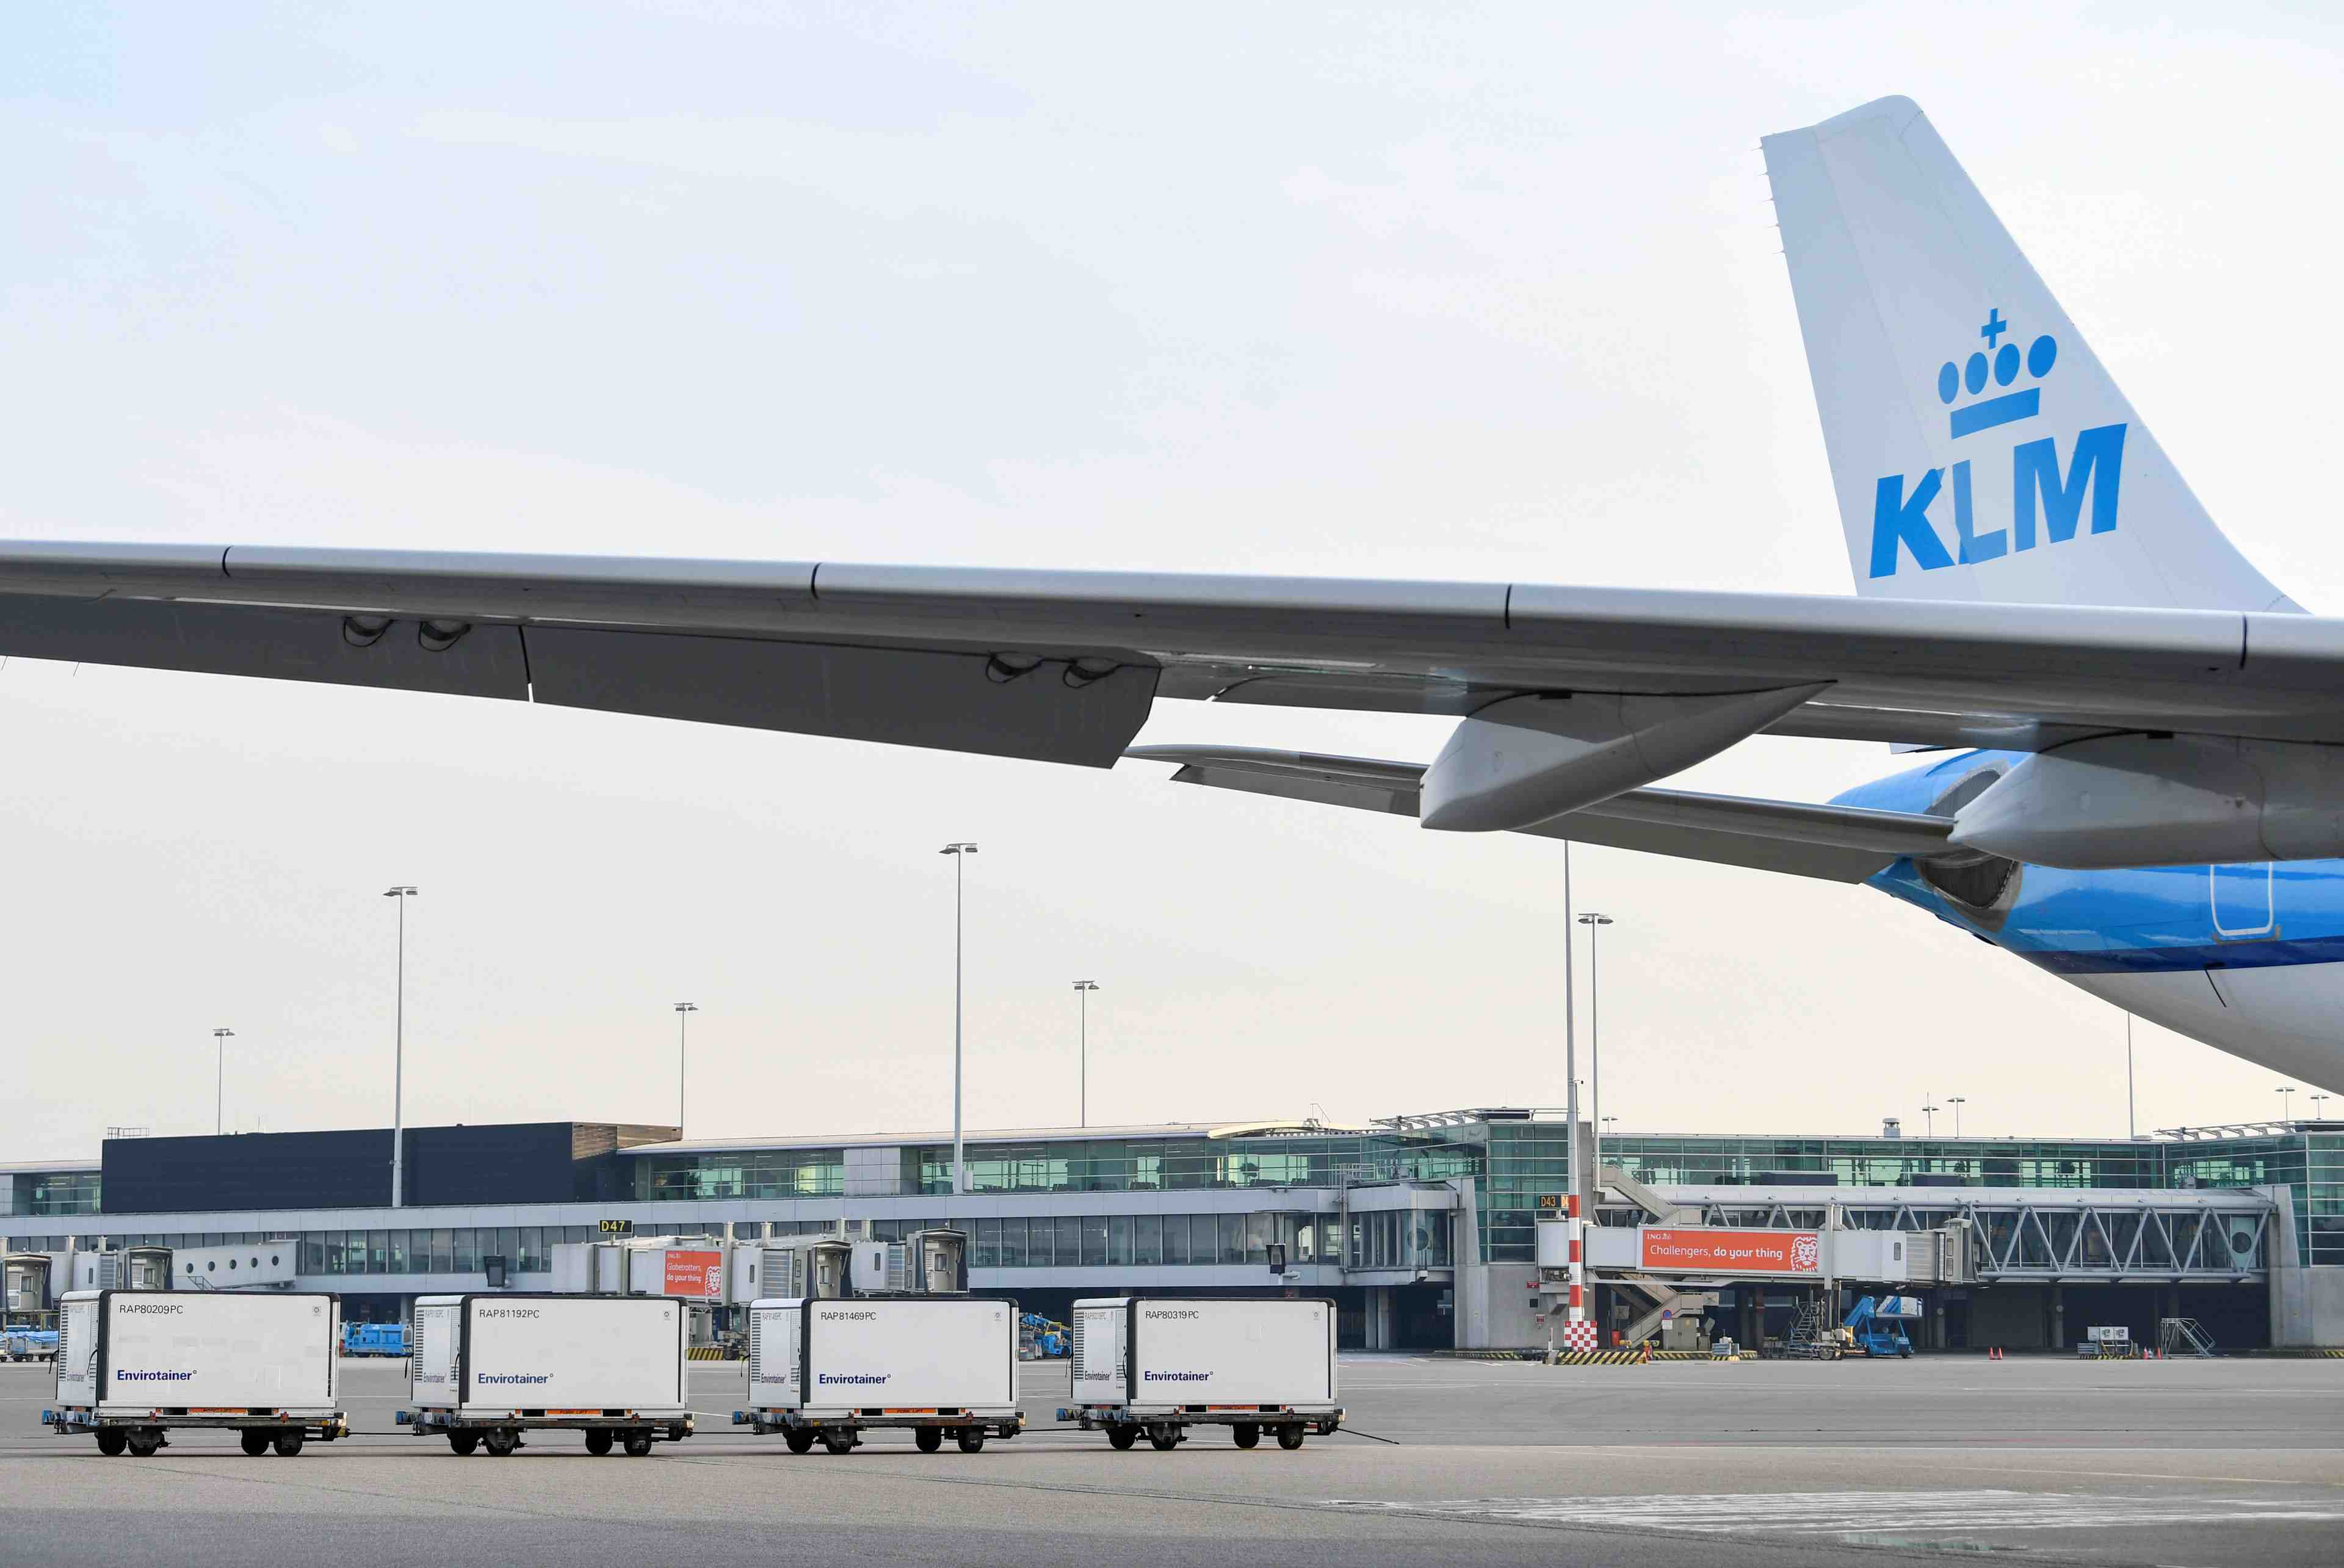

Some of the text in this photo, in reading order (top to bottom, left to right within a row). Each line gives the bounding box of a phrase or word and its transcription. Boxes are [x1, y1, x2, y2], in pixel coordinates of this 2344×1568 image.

[1869, 423, 2128, 579] KLM
[1541, 1196, 1556, 1207] D43
[601, 1221, 626, 1232] D47
[1650, 1245, 1783, 1260] Challengers, do your thing
[667, 1263, 702, 1271] Globetrotters,
[675, 1274, 687, 1283] your
[688, 1274, 701, 1283] thing
[120, 1304, 184, 1314] RAP80209PC
[479, 1309, 540, 1318] RAP81192PC
[1145, 1310, 1199, 1319] RAP80319PC
[820, 1312, 877, 1320] RAP81469PC
[117, 1369, 192, 1381] Envirotainer
[478, 1373, 548, 1384] Envirotainer
[761, 1373, 786, 1384] Envirotainer
[819, 1373, 886, 1384] Envirotainer
[1085, 1370, 1110, 1381] Envirotainer
[1145, 1371, 1209, 1381] Envirotainer
